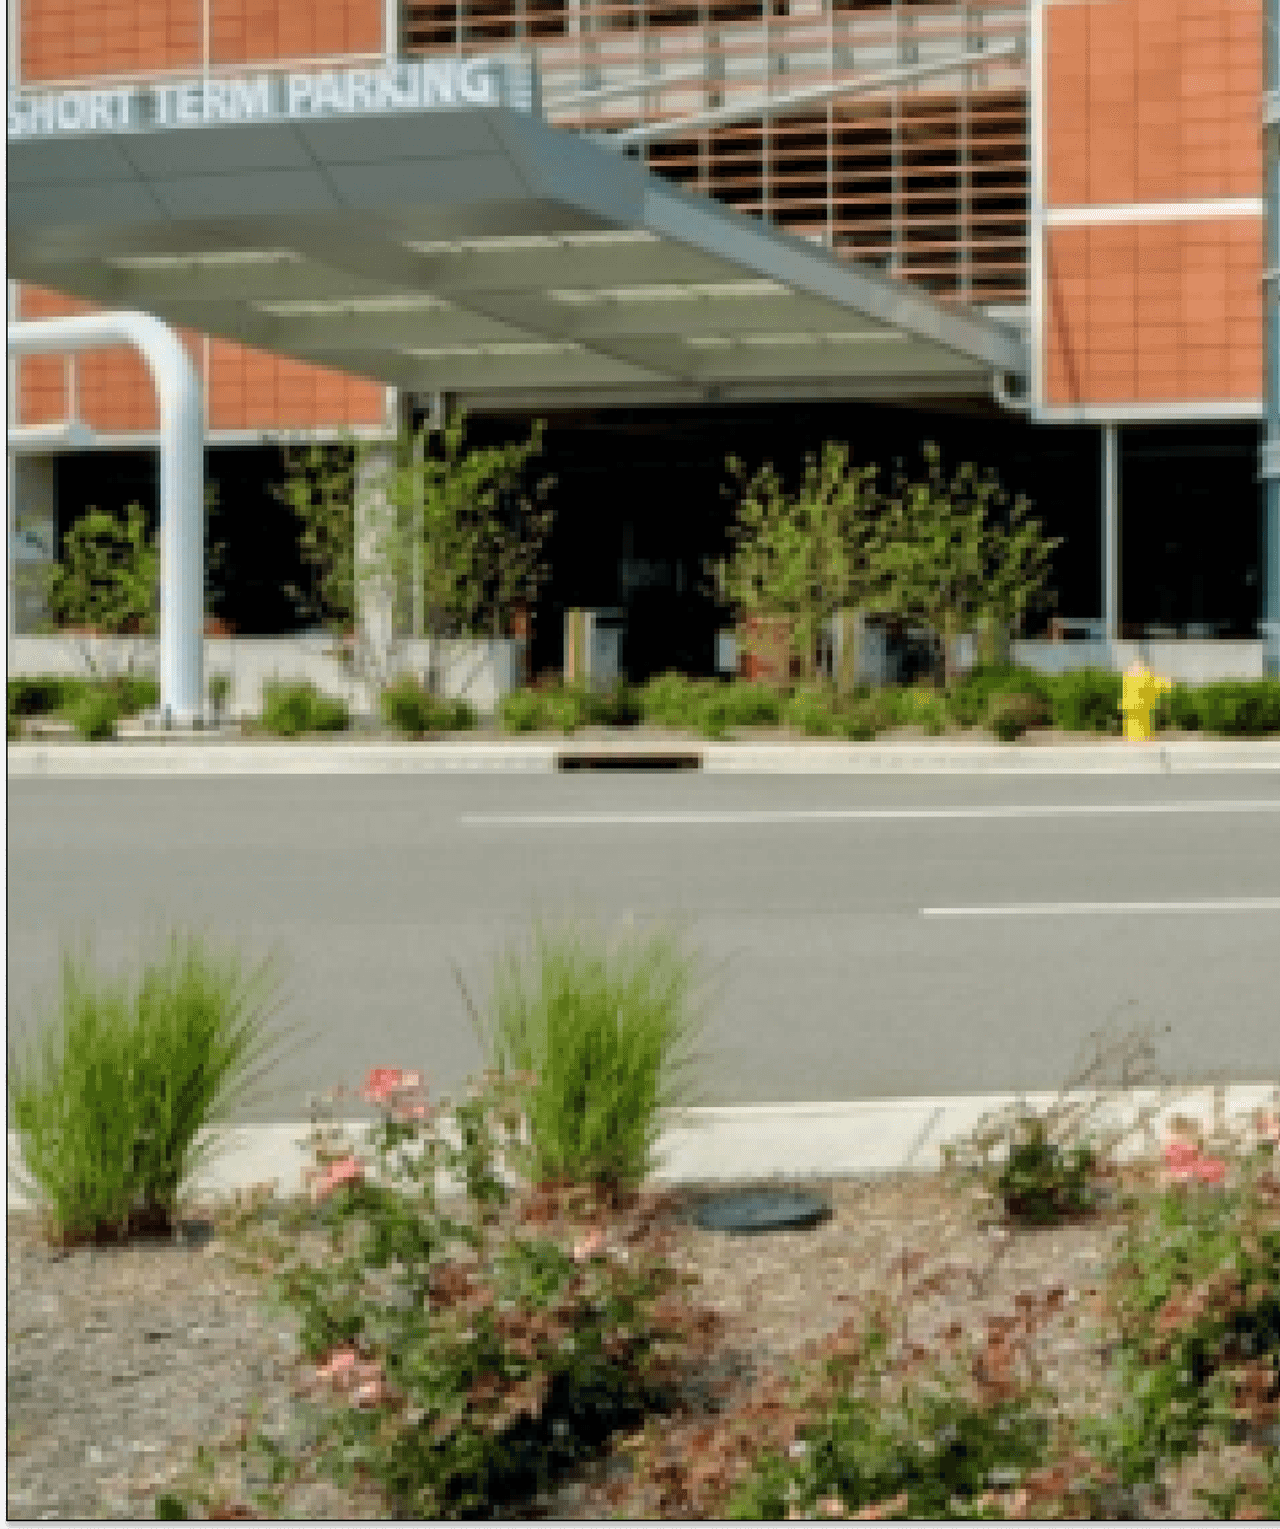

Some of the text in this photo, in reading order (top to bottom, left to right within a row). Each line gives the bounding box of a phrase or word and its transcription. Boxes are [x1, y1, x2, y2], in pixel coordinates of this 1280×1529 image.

[8, 57, 493, 134] SHORT TERM PARKING
